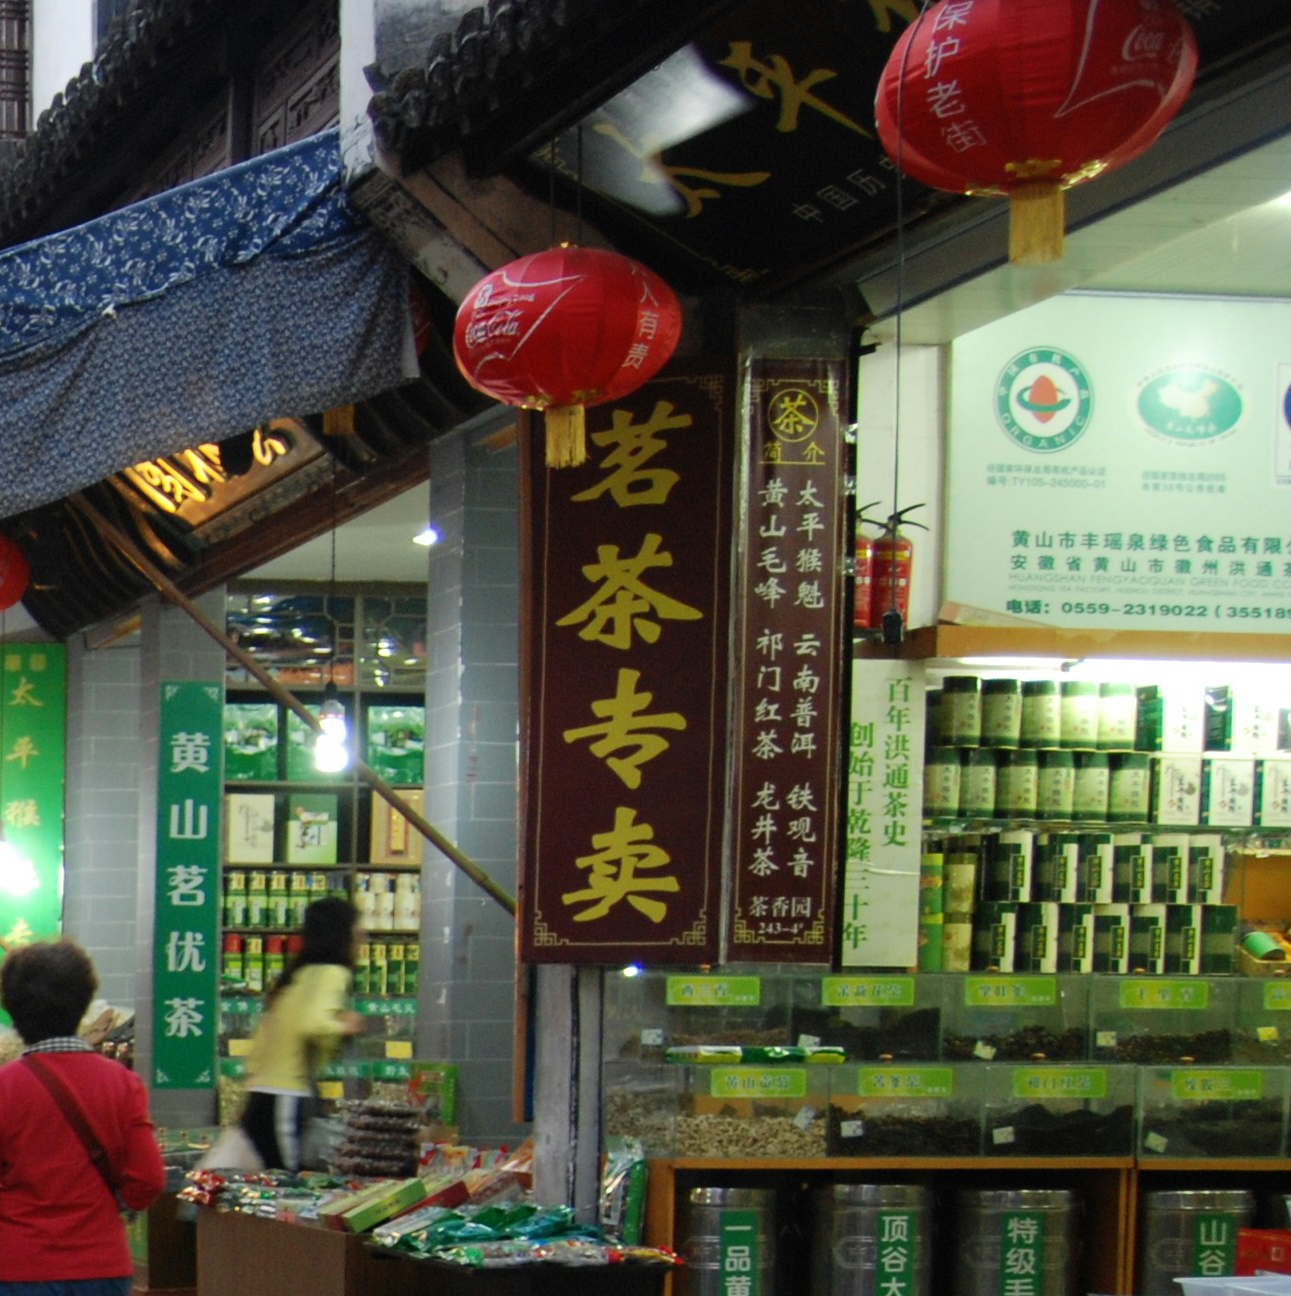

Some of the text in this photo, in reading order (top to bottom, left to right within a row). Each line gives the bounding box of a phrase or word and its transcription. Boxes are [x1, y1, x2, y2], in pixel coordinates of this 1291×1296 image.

[764, 441, 826, 462] 简介
[772, 398, 815, 434] 茶
[754, 478, 788, 609] 黄山毛峰
[795, 479, 825, 609] 太平猴魁
[1011, 530, 1291, 557] 黄山市丰瑶泉绿色食品有限
[1061, 601, 1208, 618] 0559-2319022
[556, 401, 704, 924] 茗茶专卖
[751, 629, 784, 760] 祁门红茶
[790, 633, 821, 760] 云南普洱
[881, 675, 913, 847] 百年洪通茶史
[747, 781, 780, 879] 龙井茶
[787, 783, 817, 879] 铁观音
[164, 732, 211, 1039] 黄山茗优茶
[747, 896, 812, 920] 茶香园
[1199, 1219, 1227, 1276] 山谷
